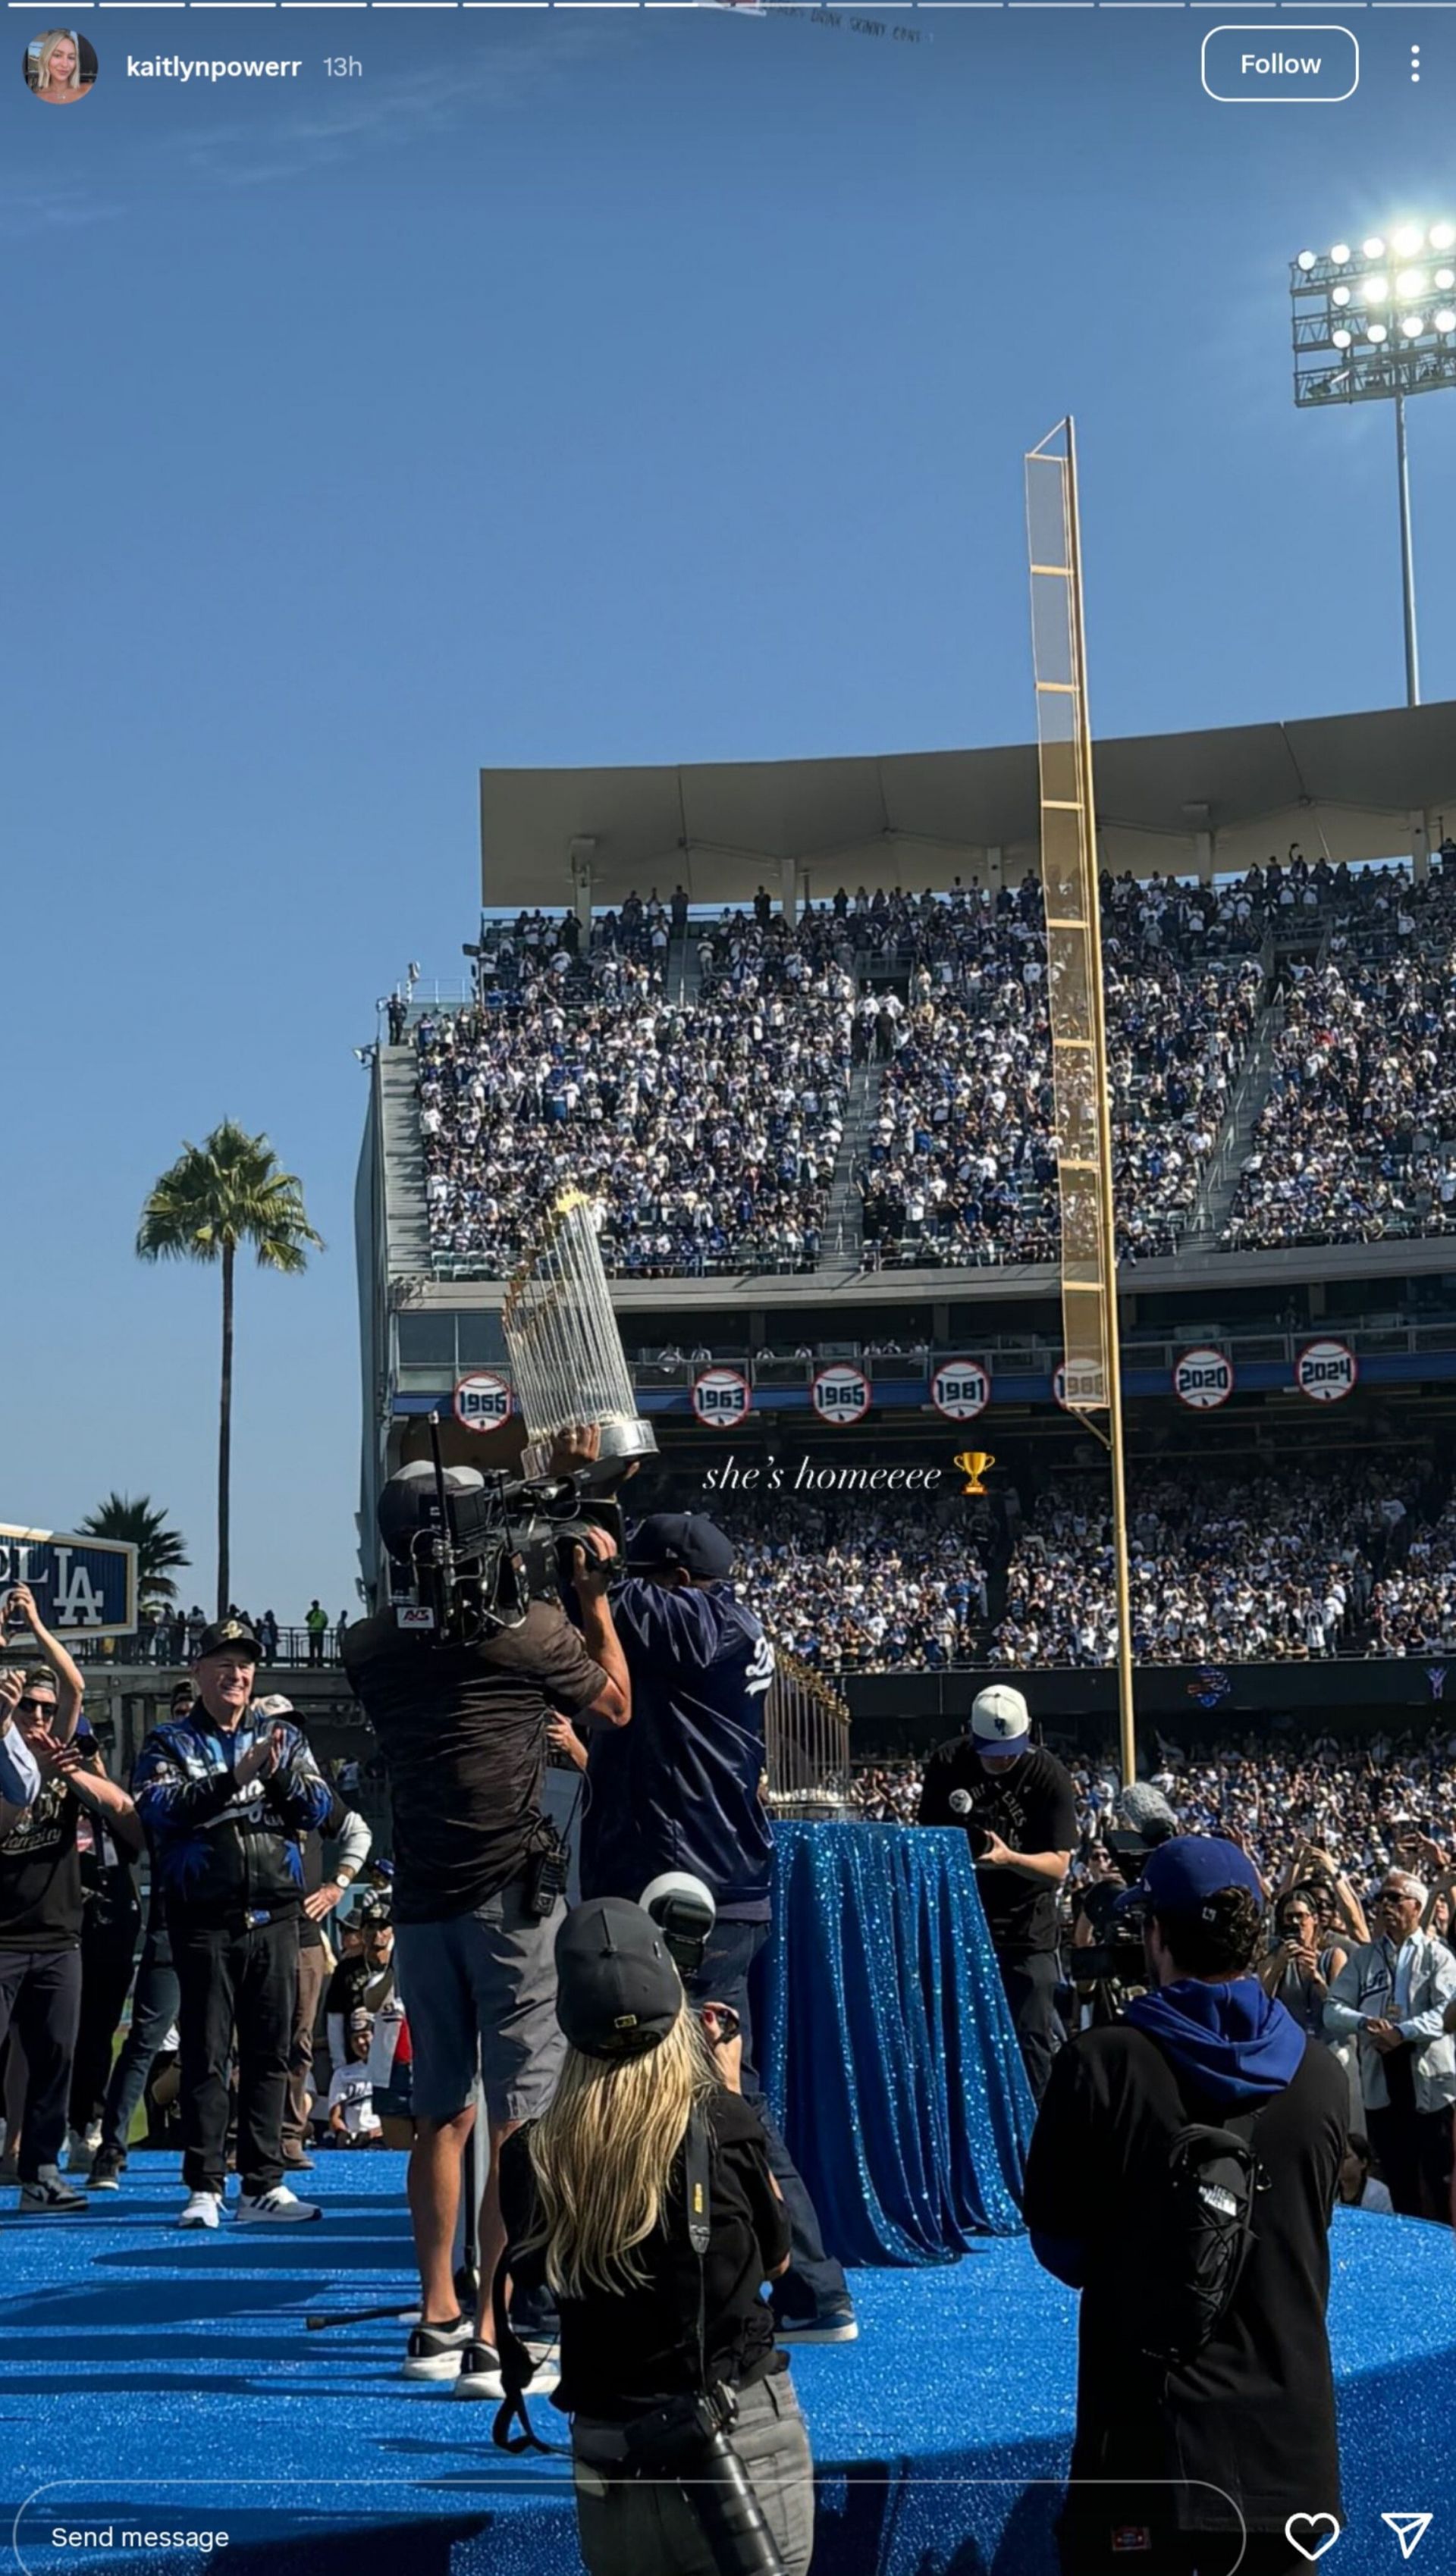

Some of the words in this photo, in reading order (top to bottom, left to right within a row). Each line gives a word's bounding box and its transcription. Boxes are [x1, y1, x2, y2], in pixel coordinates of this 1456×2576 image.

[1179, 1366, 1228, 1392] 2020
[1302, 1358, 1351, 1384] 2024
[698, 1387, 744, 1411] 1963
[817, 1383, 864, 1408] 1965
[937, 1377, 984, 1403] 1981
[53, 1547, 104, 1625] LA
